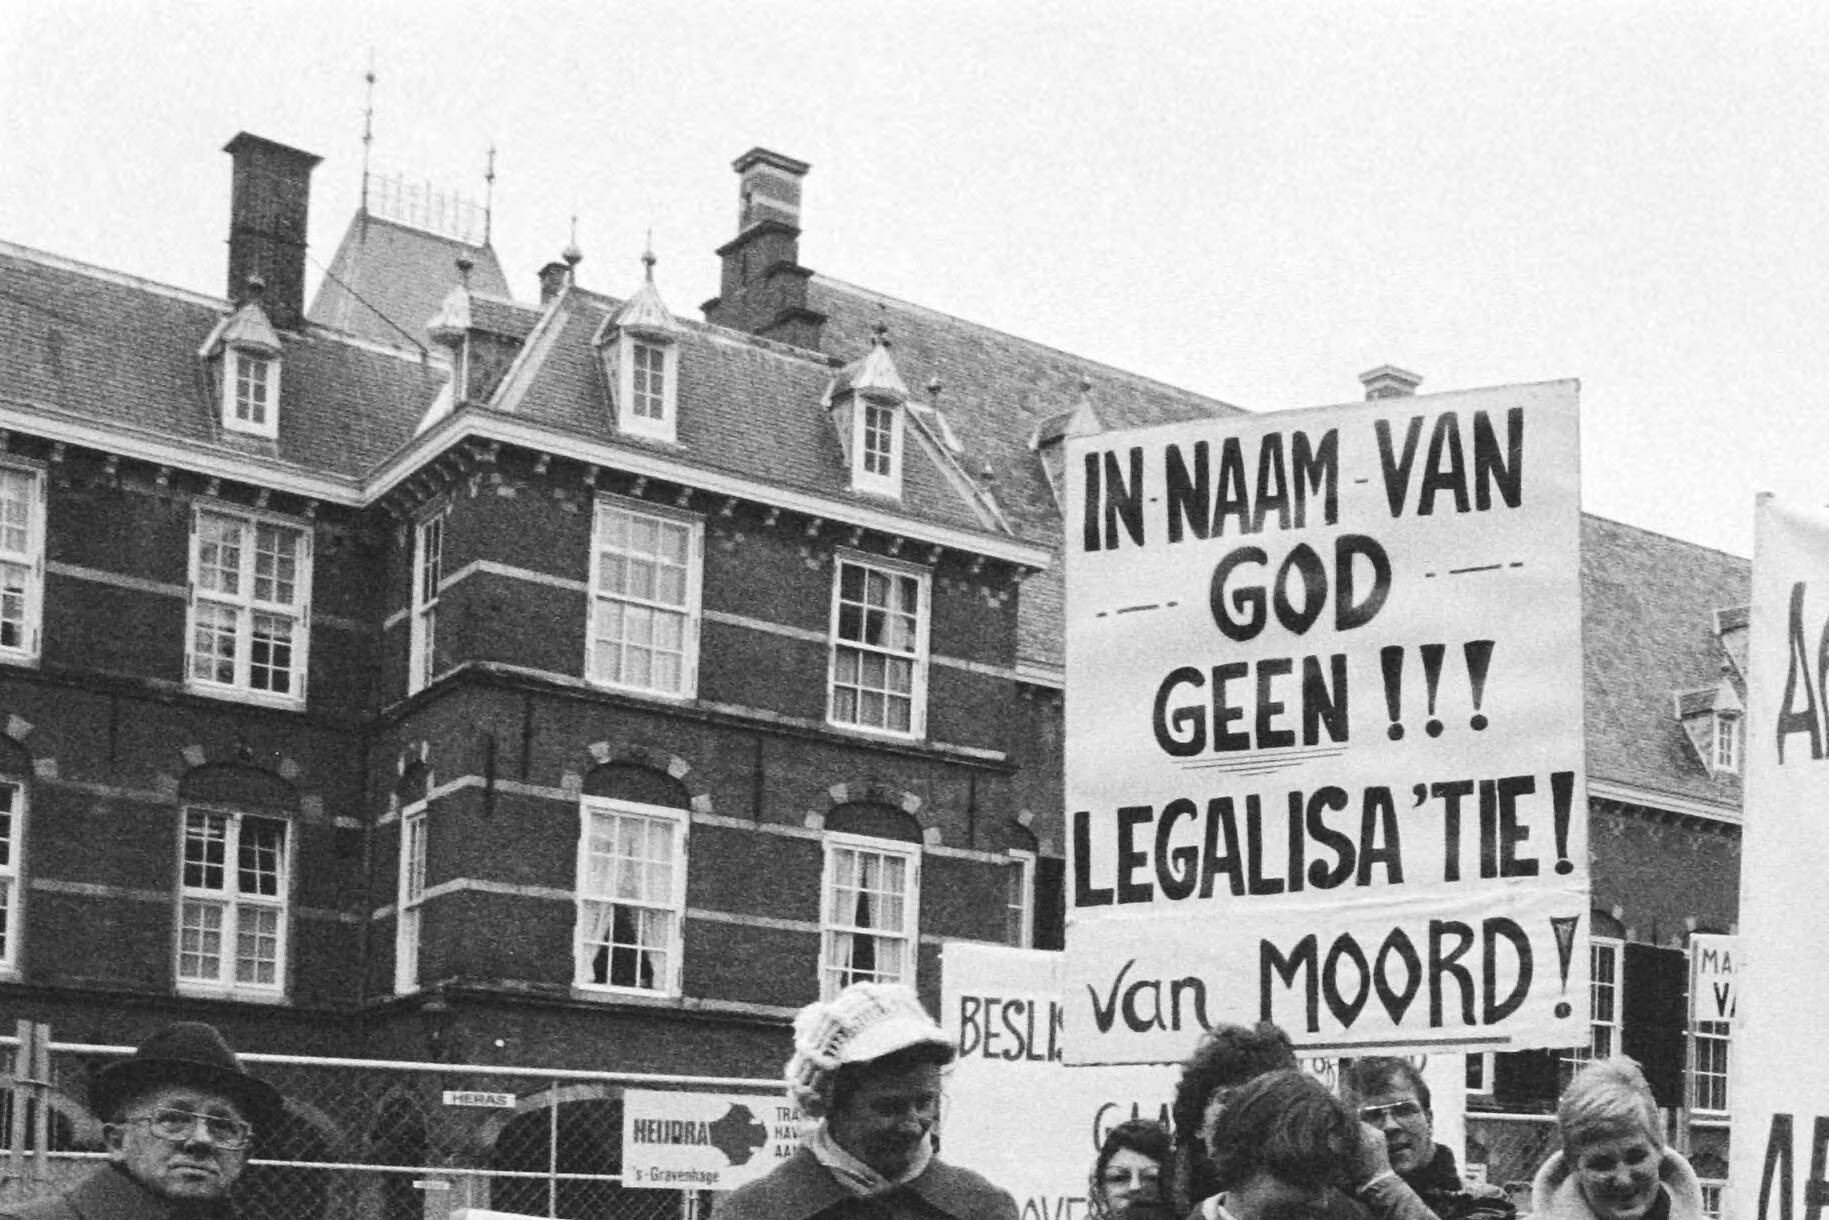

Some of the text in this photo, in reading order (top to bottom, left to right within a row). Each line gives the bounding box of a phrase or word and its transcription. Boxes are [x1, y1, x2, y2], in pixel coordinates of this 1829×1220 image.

[1209, 533, 1393, 643] GOD
[1152, 653, 1350, 758] GEEN
[1258, 915, 1581, 1034] MOORD!
